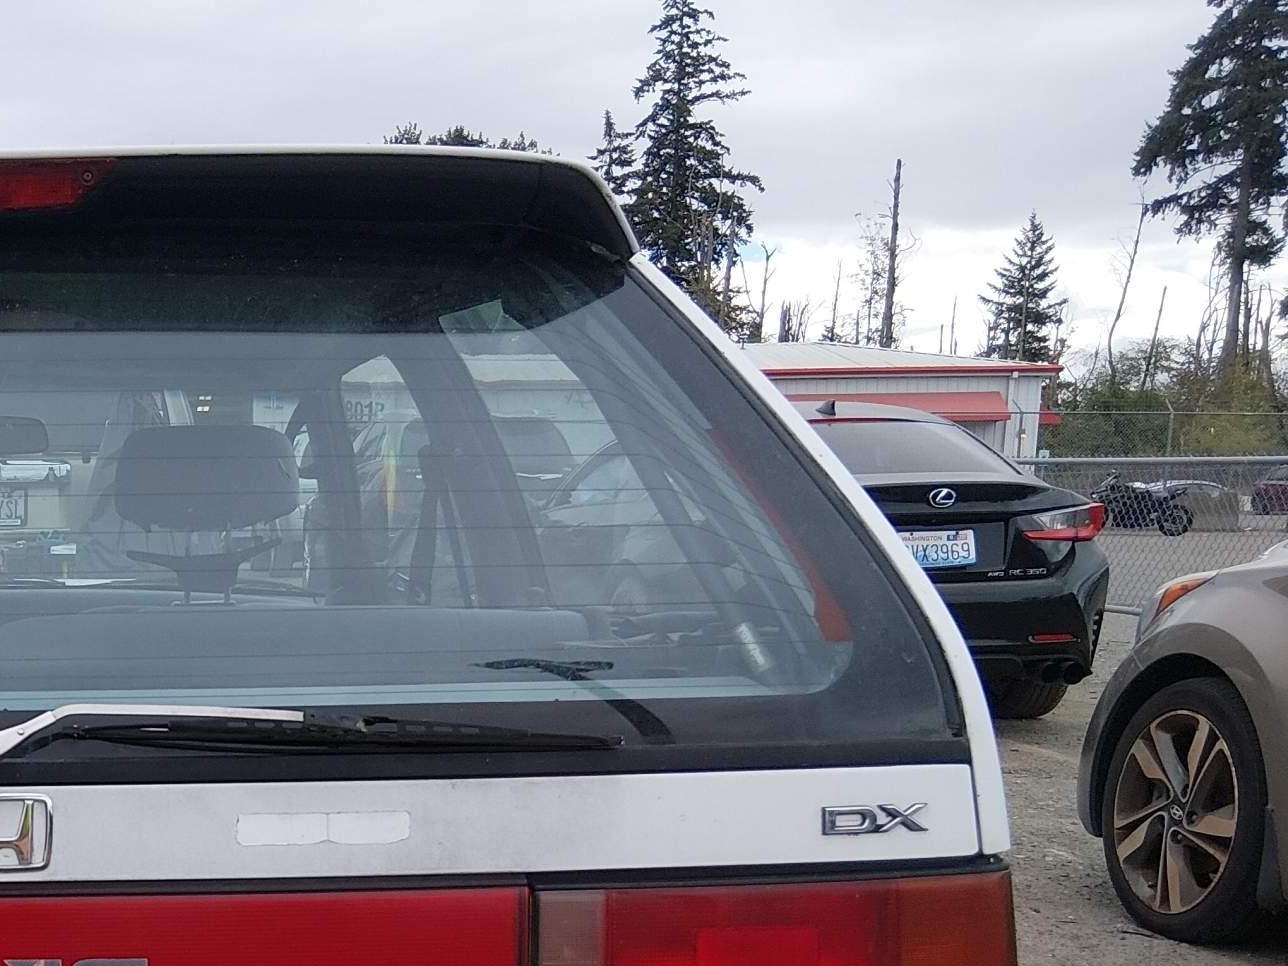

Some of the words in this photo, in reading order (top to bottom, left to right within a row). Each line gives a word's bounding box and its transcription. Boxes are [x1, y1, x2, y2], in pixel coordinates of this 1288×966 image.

[906, 542, 971, 562] VX3969
[1026, 568, 1047, 576] 350
[821, 802, 928, 836] DX
